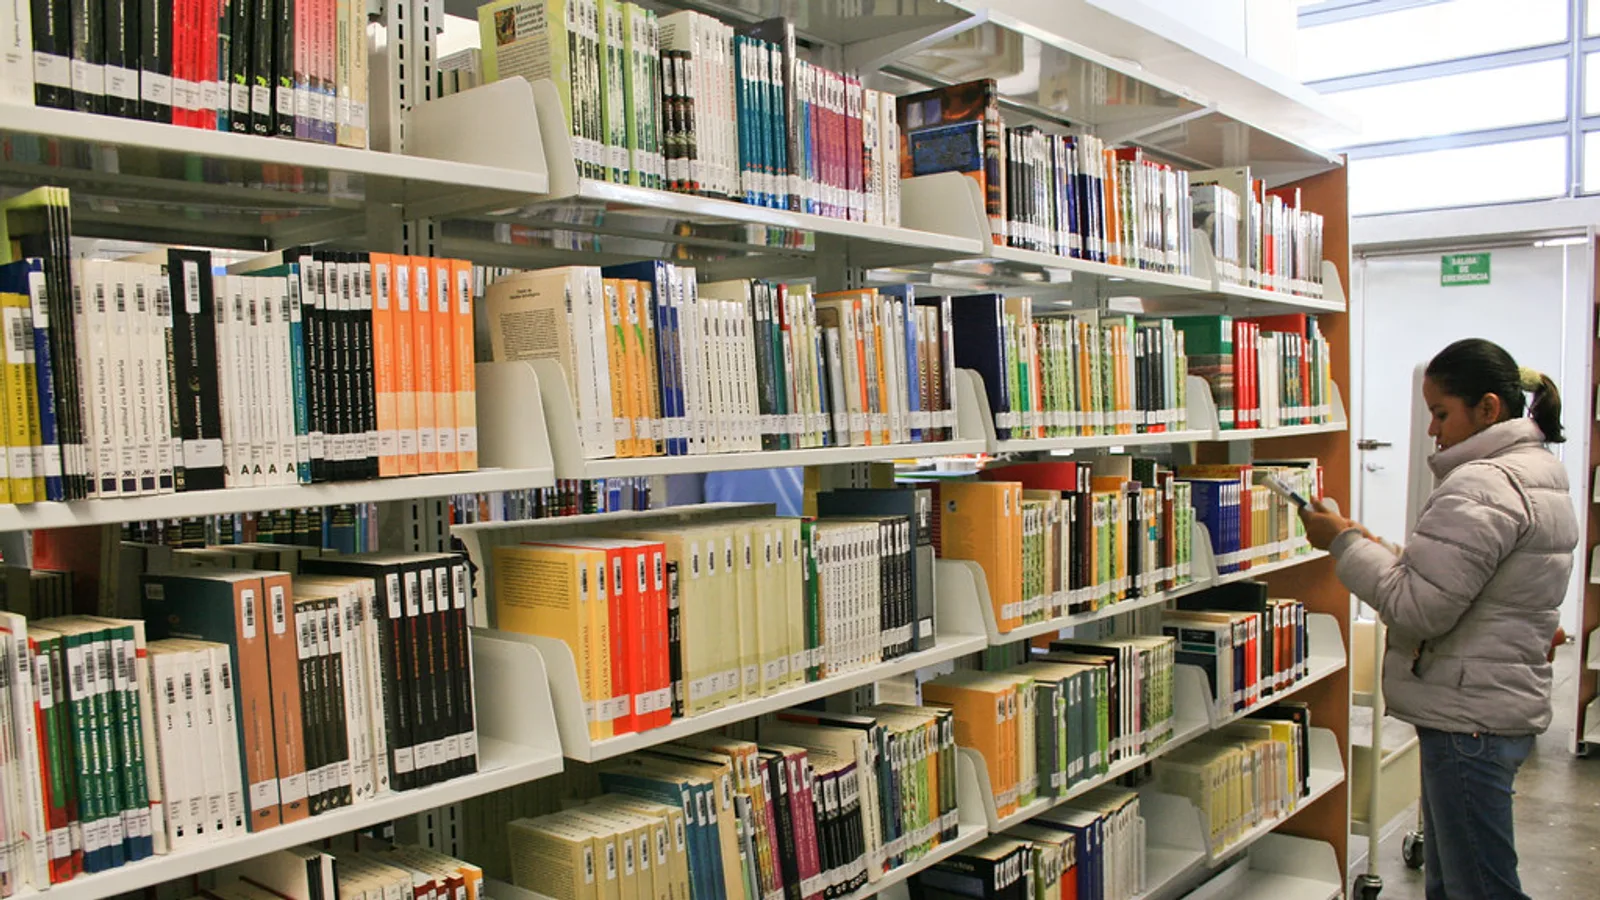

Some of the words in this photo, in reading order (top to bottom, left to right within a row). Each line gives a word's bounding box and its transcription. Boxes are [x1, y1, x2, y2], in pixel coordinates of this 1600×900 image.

[1452, 257, 1476, 266] SALIDA
[1459, 265, 1469, 274] DE
[1442, 272, 1488, 283] EMERGENCIA
[241, 464, 249, 475] A
[253, 464, 262, 475] A
[268, 463, 277, 474] A
[286, 462, 295, 473] A
